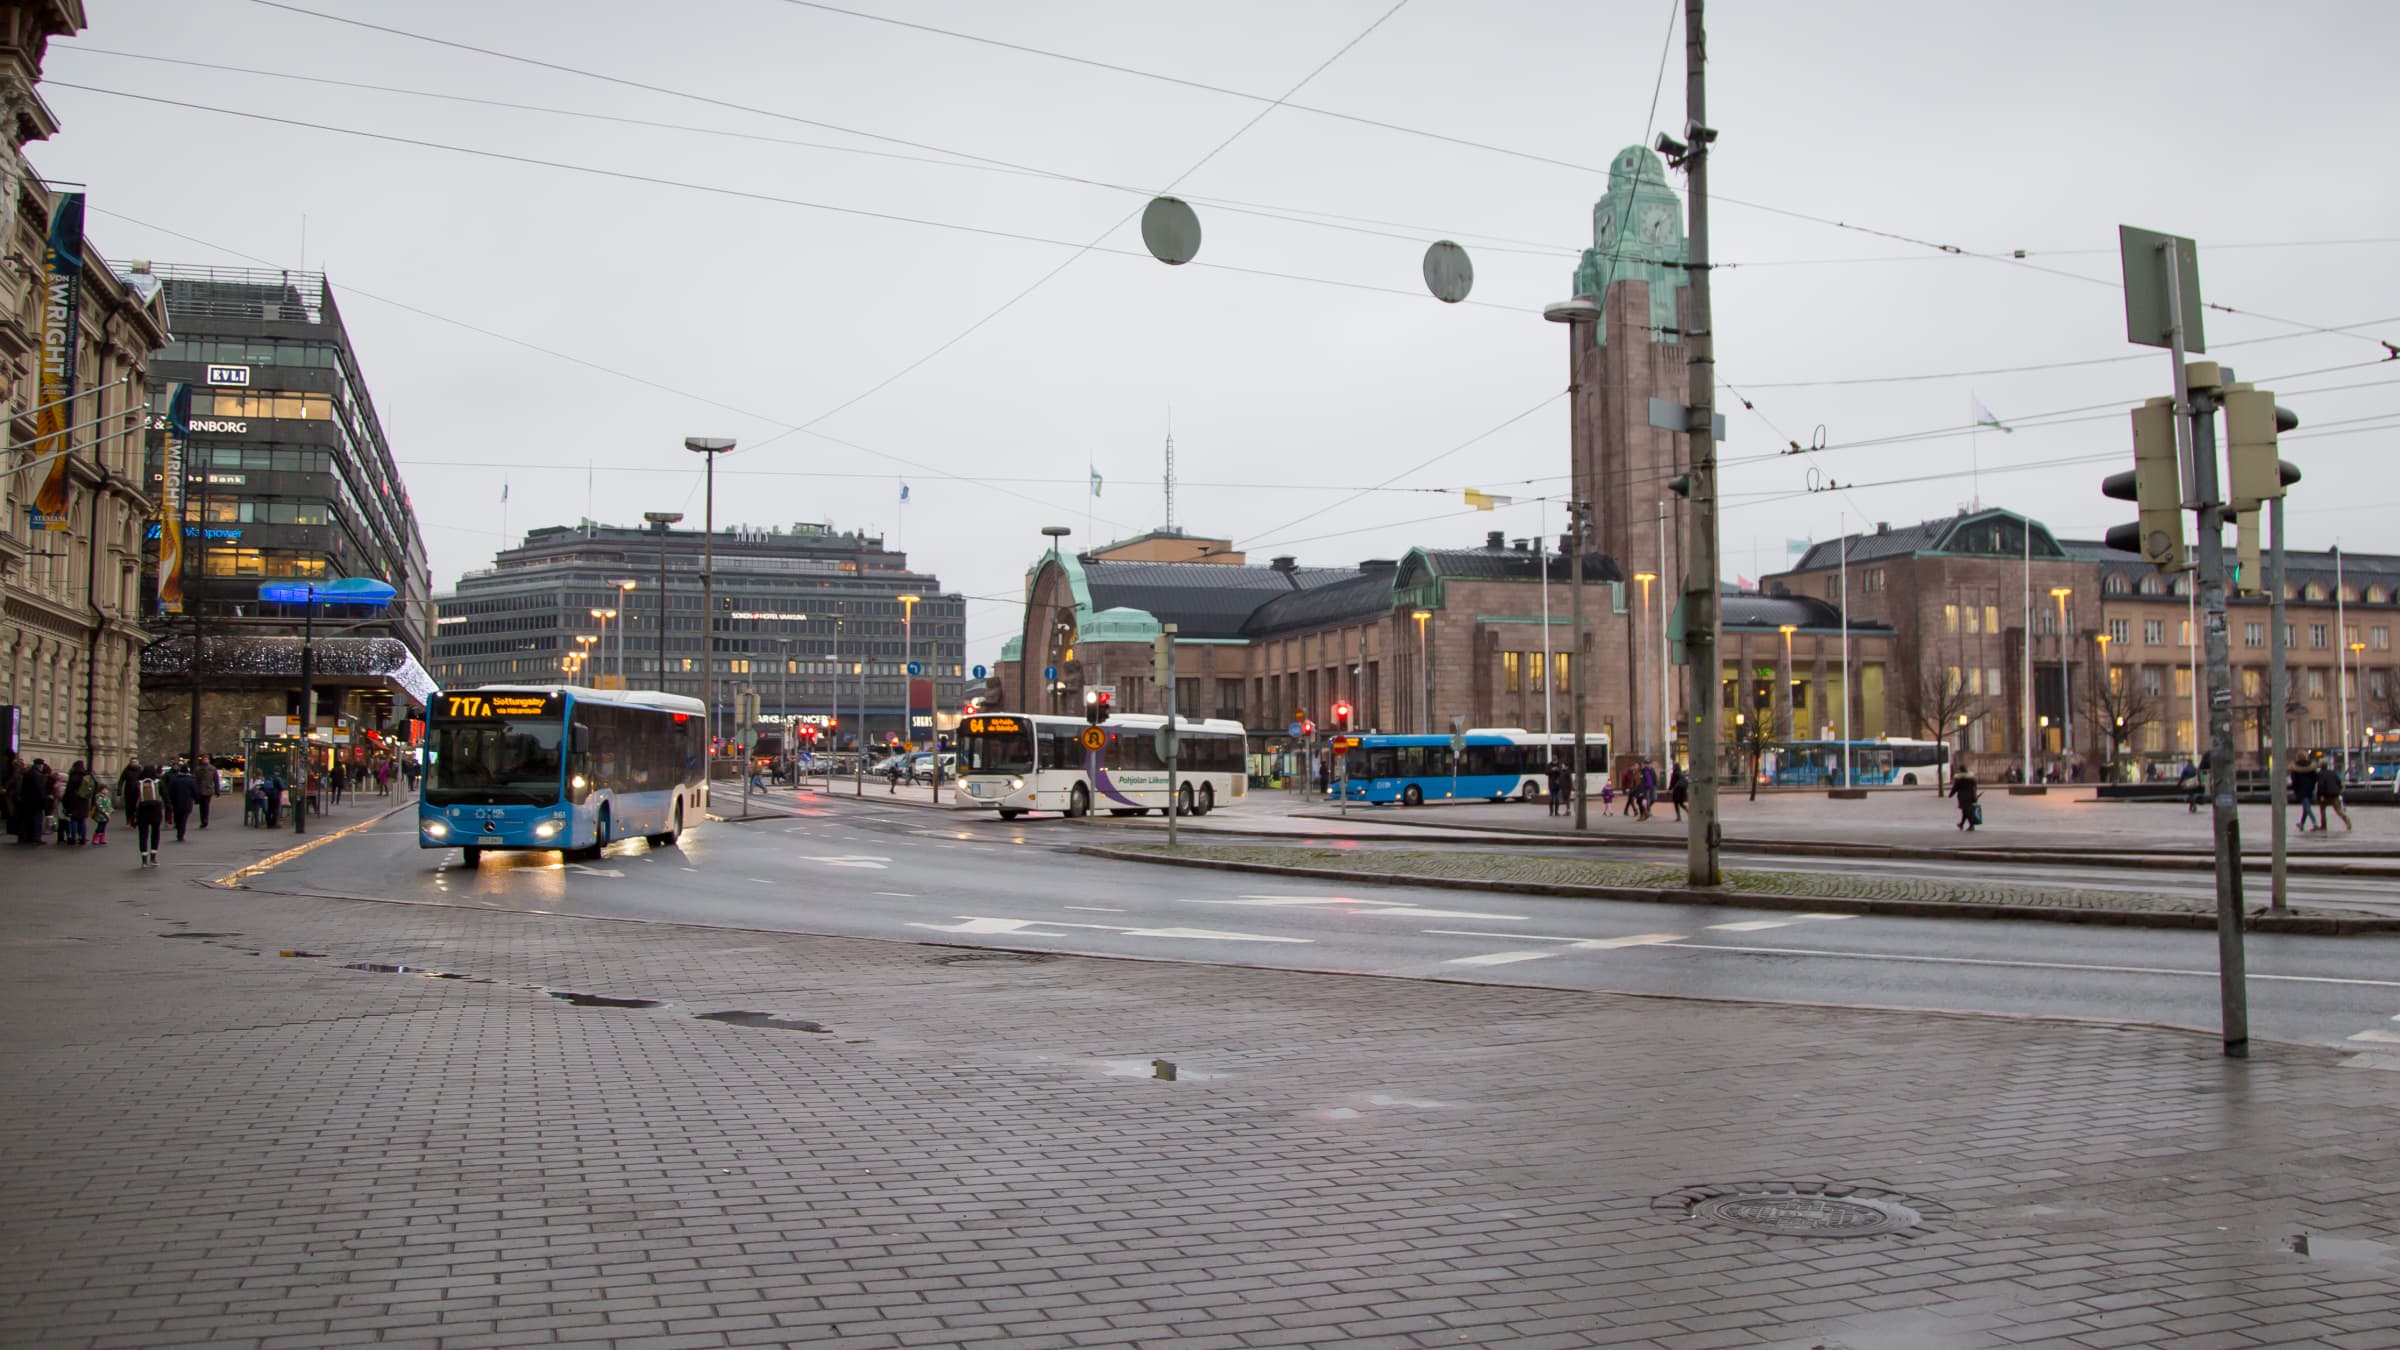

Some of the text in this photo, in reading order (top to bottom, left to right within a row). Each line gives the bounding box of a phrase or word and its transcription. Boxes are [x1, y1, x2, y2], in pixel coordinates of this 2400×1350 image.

[44, 283, 70, 377] WRIGHT
[212, 369, 245, 382] EVLI
[189, 420, 247, 434] RNBORG
[166, 445, 182, 509] WRIGHT
[209, 475, 241, 484] Bank
[970, 718, 984, 733] 64
